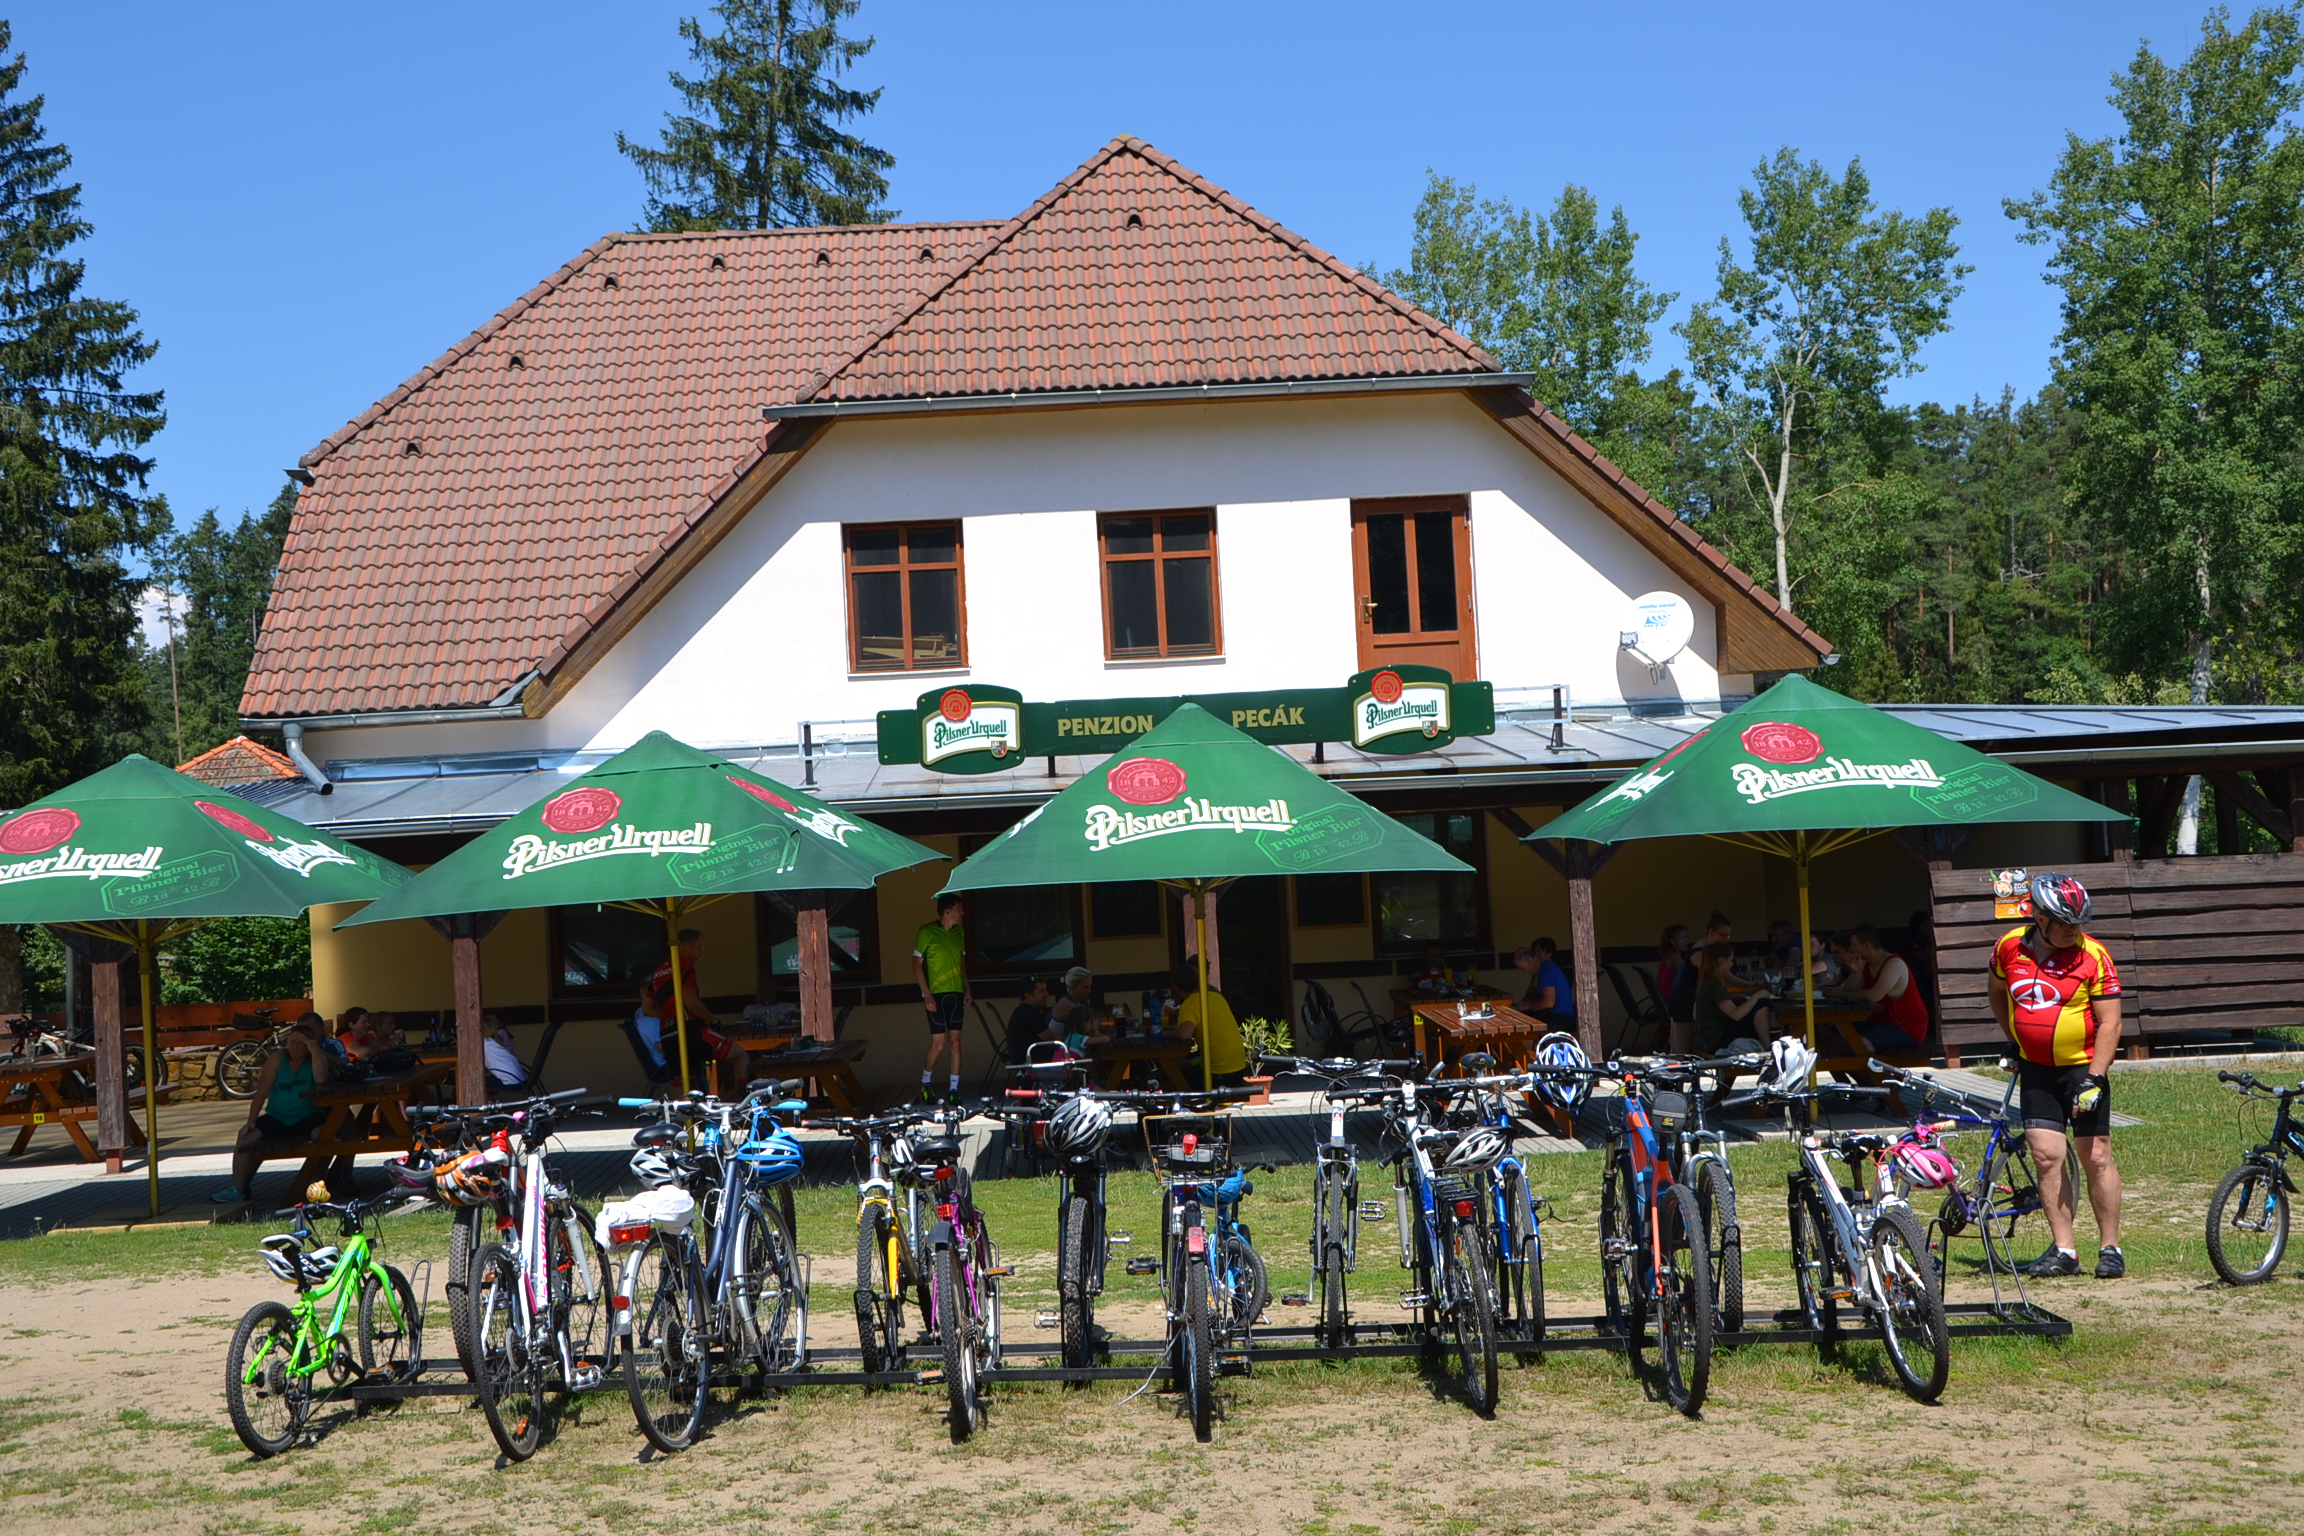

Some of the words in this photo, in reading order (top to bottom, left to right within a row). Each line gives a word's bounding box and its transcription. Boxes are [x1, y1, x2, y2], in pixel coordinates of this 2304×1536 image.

[1057, 715, 1154, 737] PENZION
[1232, 704, 1306, 728] PECÁK
[1366, 703, 1403, 729] Pilsner
[1402, 700, 1437, 719] Urquell
[934, 721, 971, 749] Pilsner
[970, 719, 1007, 739] Urquell
[1162, 776, 1176, 784] 42
[1731, 763, 1836, 804] Pilsner
[1825, 756, 1940, 789] Urquell
[1926, 785, 1978, 805] Pilsner
[1978, 775, 2012, 790] Bier
[596, 804, 610, 812] 42
[1085, 804, 1191, 852] Pilsner
[1184, 796, 1294, 833] Urquell
[1270, 829, 1326, 852] Pilsner
[1328, 816, 1363, 834] Bier
[53, 846, 164, 880] Urquell
[502, 835, 615, 880] Pilsner
[609, 823, 713, 857] Urquell
[680, 849, 740, 873] Pilsner
[748, 836, 780, 853] Bier
[115, 875, 181, 897] Pilsner
[188, 863, 226, 880] Bier
